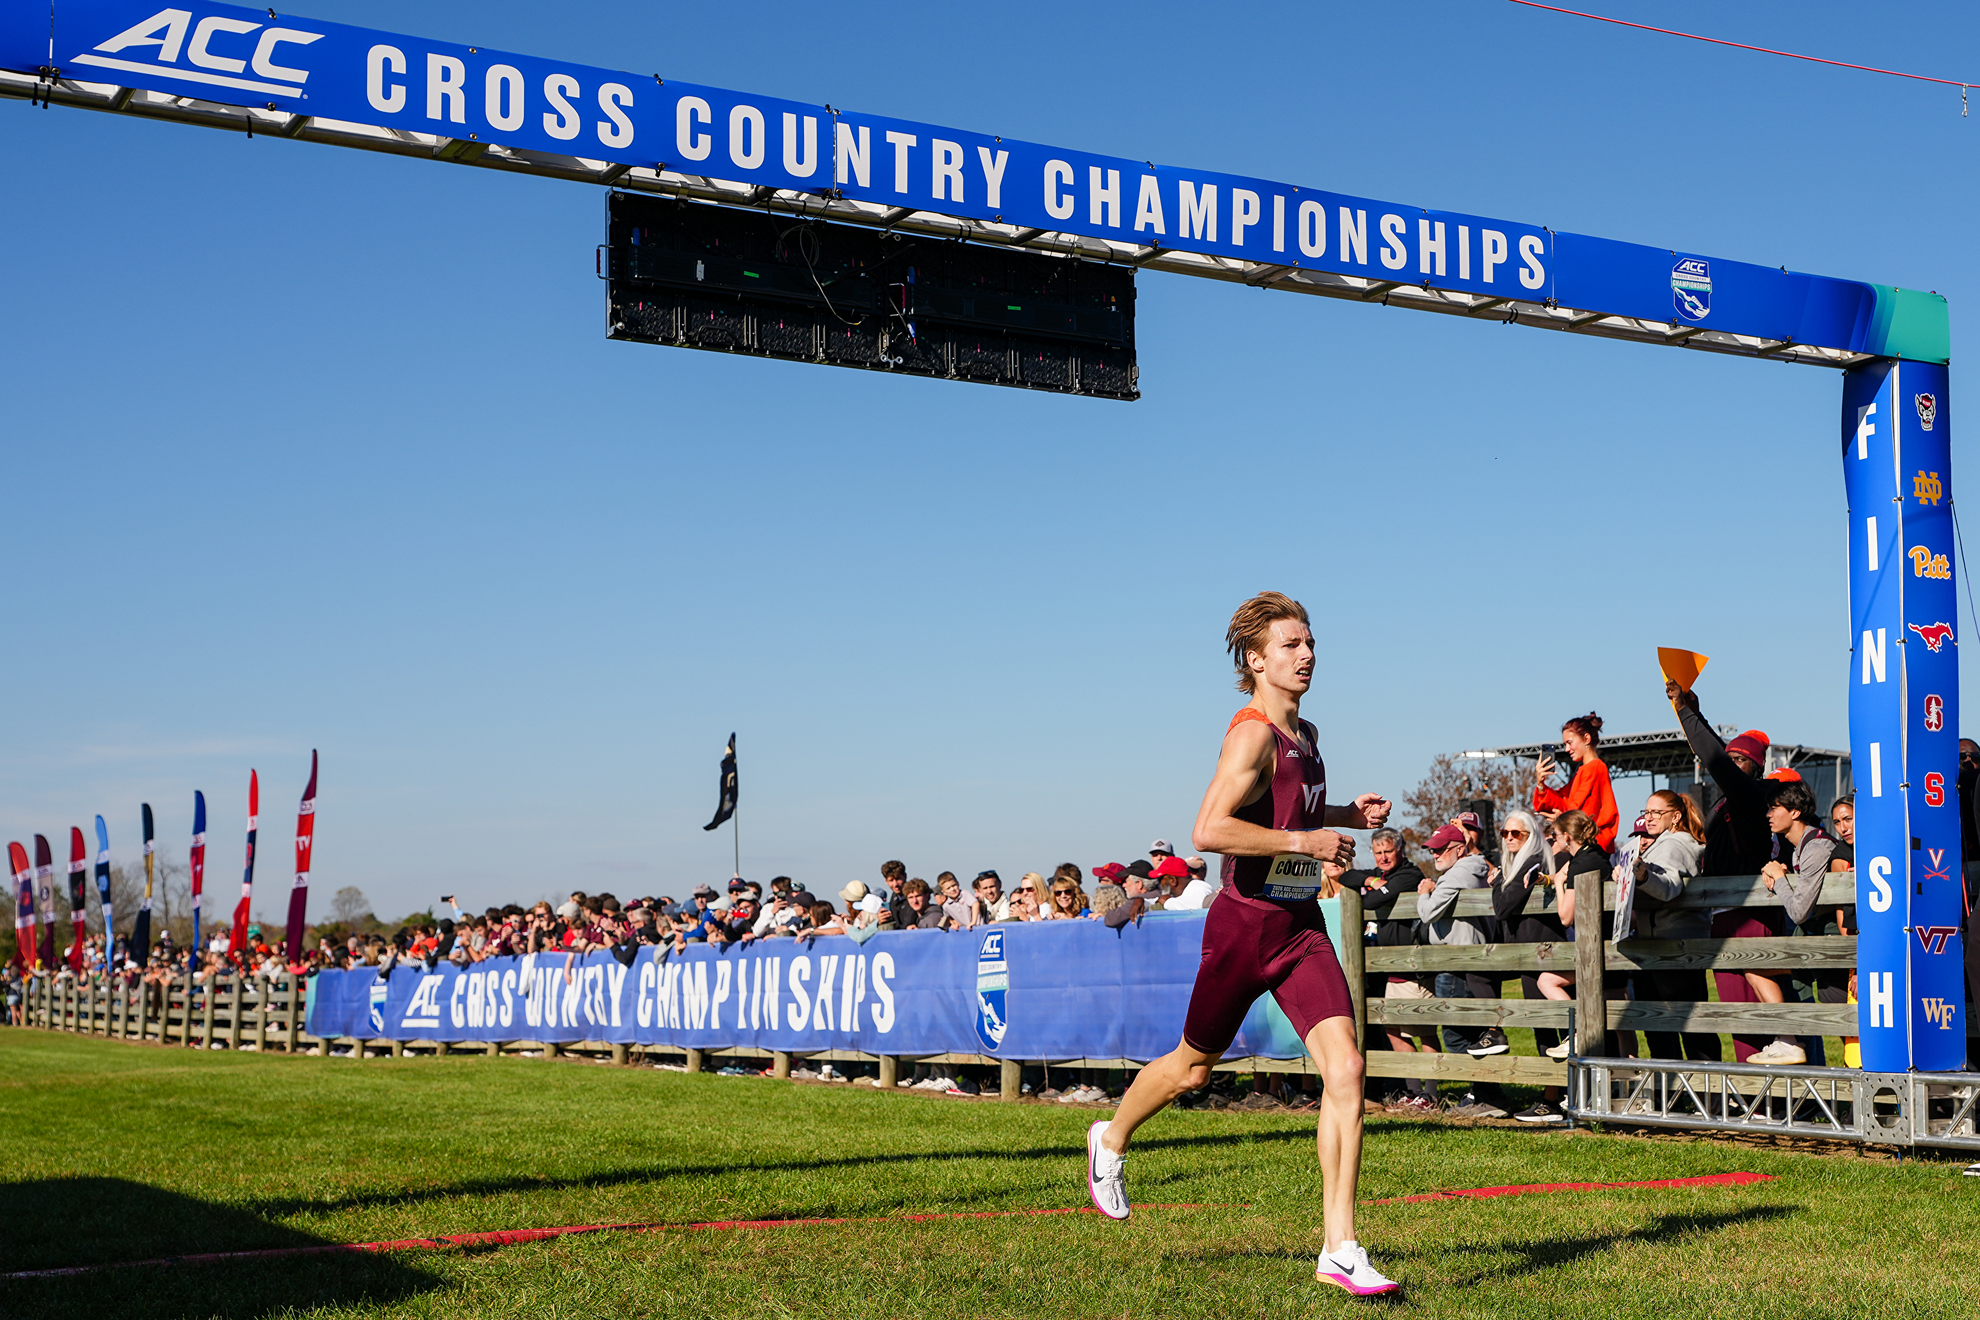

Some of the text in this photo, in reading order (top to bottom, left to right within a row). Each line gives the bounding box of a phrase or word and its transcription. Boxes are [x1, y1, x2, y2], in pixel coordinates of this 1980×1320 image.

[92, 8, 1545, 290] ACC CROSS COUNTRY CHAMPIONSHIPS
[1680, 260, 1706, 274] ACC
[1908, 544, 1951, 580] Pitt
[1300, 782, 1325, 815] VT
[1275, 860, 1318, 877] COUTTIE
[981, 934, 1002, 954] ACC
[1915, 925, 1958, 954] VT
